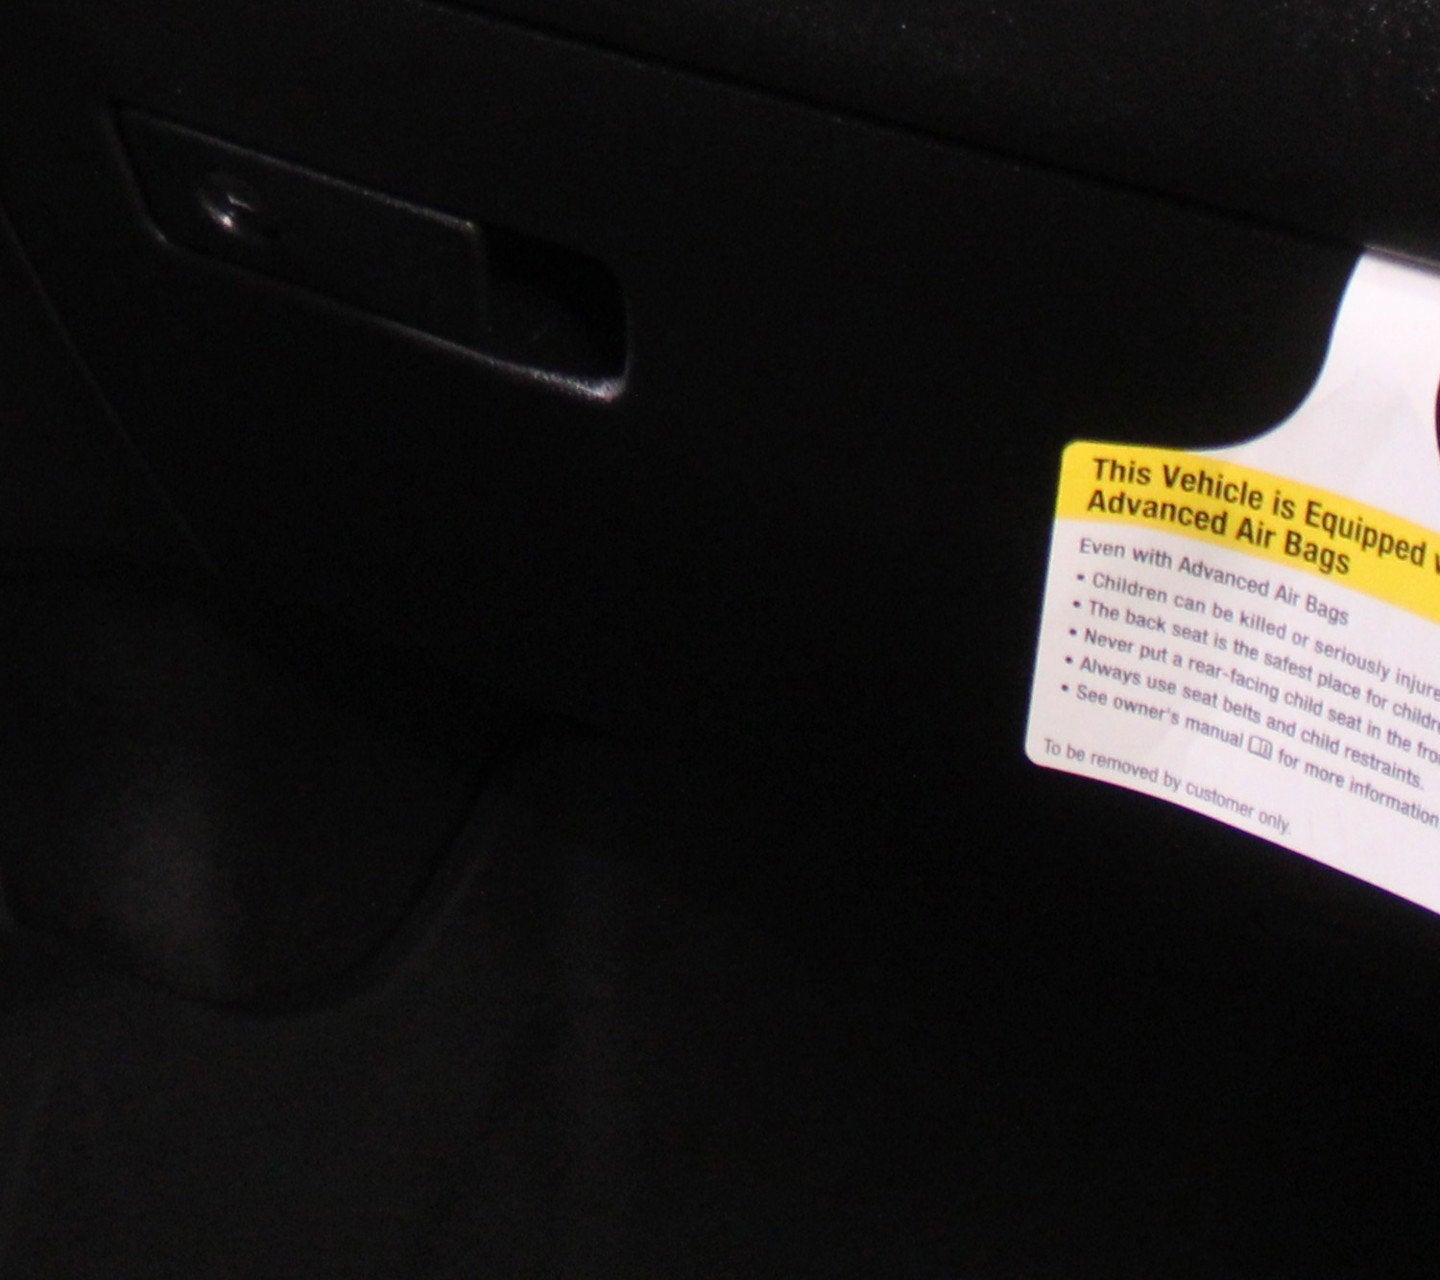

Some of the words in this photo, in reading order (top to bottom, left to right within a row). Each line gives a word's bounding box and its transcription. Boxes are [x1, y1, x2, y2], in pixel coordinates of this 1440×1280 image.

[1087, 489, 1228, 535] Advanced
[1236, 517, 1277, 549] Air
[1284, 530, 1350, 574] Bags
[1093, 457, 1151, 485] This
[1163, 464, 1263, 510] Vehicle
[1273, 490, 1296, 519] is
[1305, 500, 1427, 567] Equipped
[1080, 538, 1125, 558] Even
[1132, 547, 1172, 570] with
[1178, 556, 1270, 597] Advanced
[1274, 585, 1301, 607] Air
[1306, 594, 1349, 626] Bags
[1093, 572, 1167, 603] Children
[1174, 594, 1206, 614] can
[1212, 602, 1233, 622] be
[1240, 611, 1286, 640] killed
[1292, 632, 1309, 648] or
[1314, 640, 1391, 683] seriously
[1085, 628, 1133, 654] Never
[1139, 643, 1168, 663] put
[1173, 654, 1183, 668] a
[1188, 657, 1279, 703] rear-facing
[1284, 691, 1324, 717] child
[1328, 708, 1362, 733] seat
[1367, 720, 1381, 739] in
[1387, 728, 1412, 752] the
[1089, 599, 1120, 621] The
[1126, 608, 1167, 633] back
[1172, 623, 1209, 645] seat
[1213, 633, 1228, 651] is
[1233, 639, 1259, 660] the
[1264, 652, 1314, 681] safest
[1318, 673, 1362, 700] place
[1366, 689, 1388, 710] for
[1076, 684, 1108, 706] See
[1113, 696, 1180, 725] owner's
[1185, 717, 1244, 749] manual
[1278, 749, 1300, 770] for
[1304, 762, 1345, 789] more
[1349, 776, 1439, 828] information
[1079, 656, 1142, 686] Always
[1146, 676, 1177, 695] use
[1182, 686, 1219, 709] seat
[1223, 696, 1262, 724] belts
[1266, 716, 1297, 738] and
[1301, 729, 1341, 756] child
[1344, 745, 1424, 790] restraints.
[1044, 738, 1061, 756] To
[1066, 743, 1085, 762] be
[1091, 753, 1159, 783] removed
[1163, 771, 1181, 792] by
[1186, 781, 1255, 819] customer
[1258, 810, 1292, 836] only.
